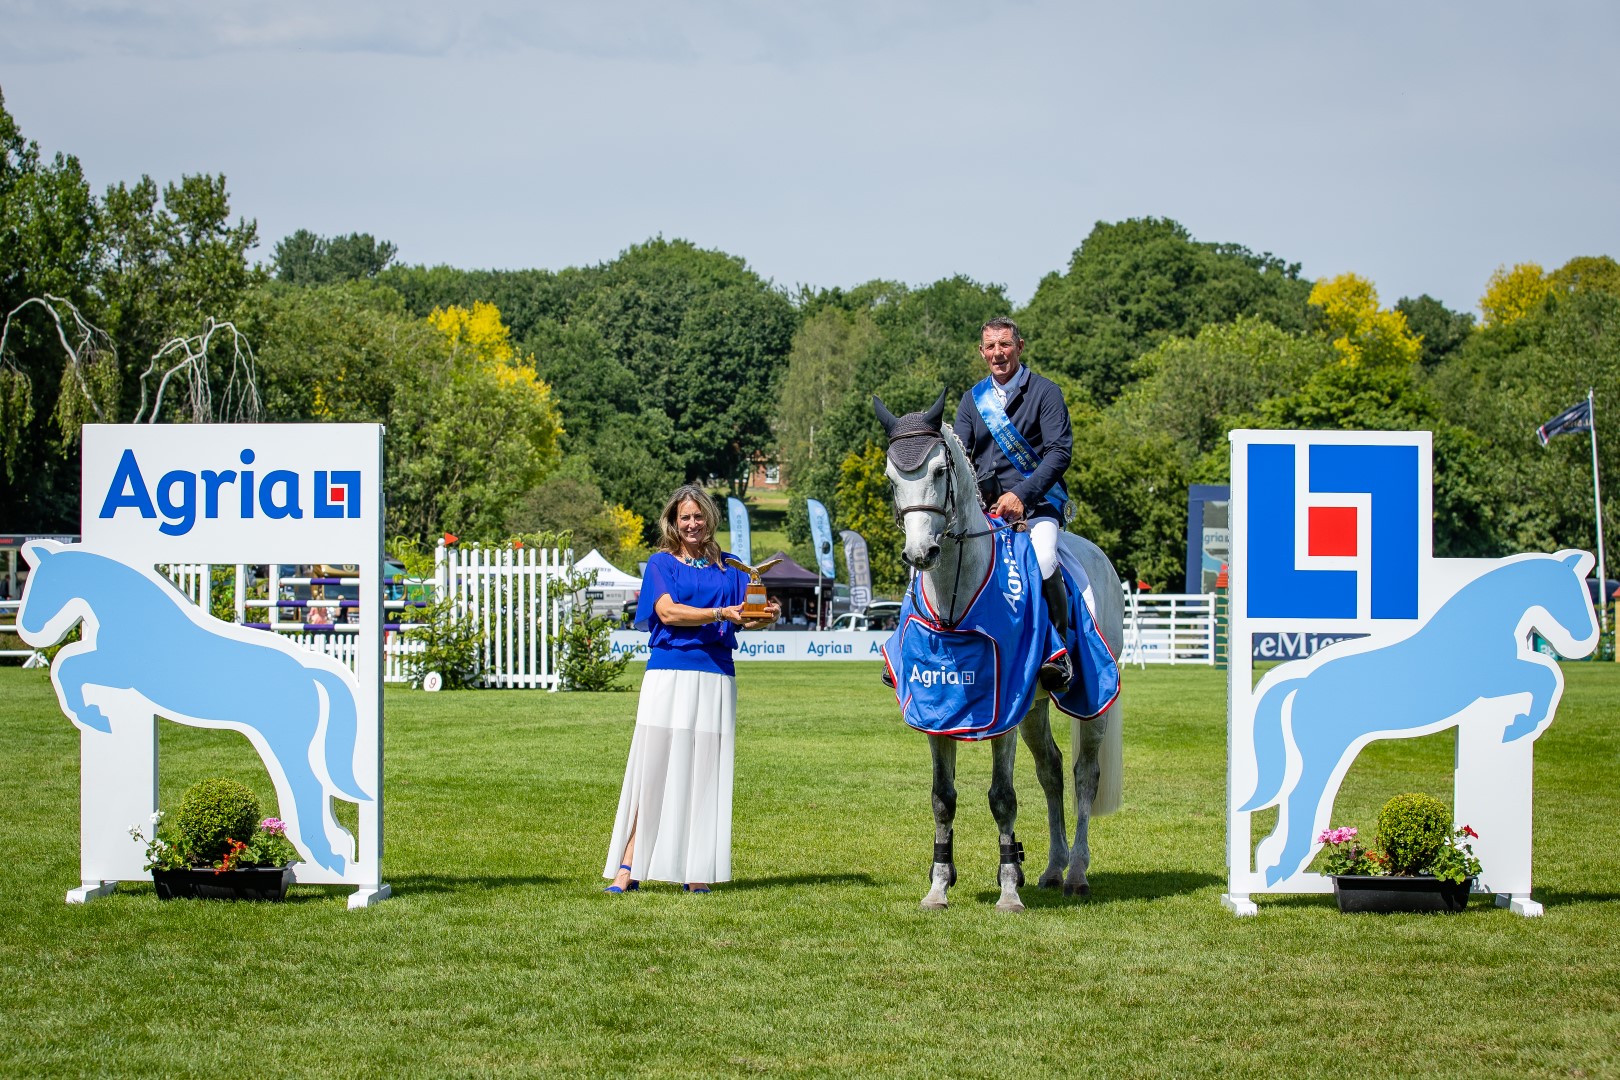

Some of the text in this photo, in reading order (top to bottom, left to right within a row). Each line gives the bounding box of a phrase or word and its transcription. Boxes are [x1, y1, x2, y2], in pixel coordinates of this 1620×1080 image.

[999, 433, 1029, 470] DERBY TRIAL
[99, 448, 303, 536] Agria
[1204, 532, 1224, 545] gria
[739, 640, 775, 657] Agria
[807, 640, 842, 657] Agria
[428, 677, 437, 689] 9
[909, 664, 959, 688] Agria
